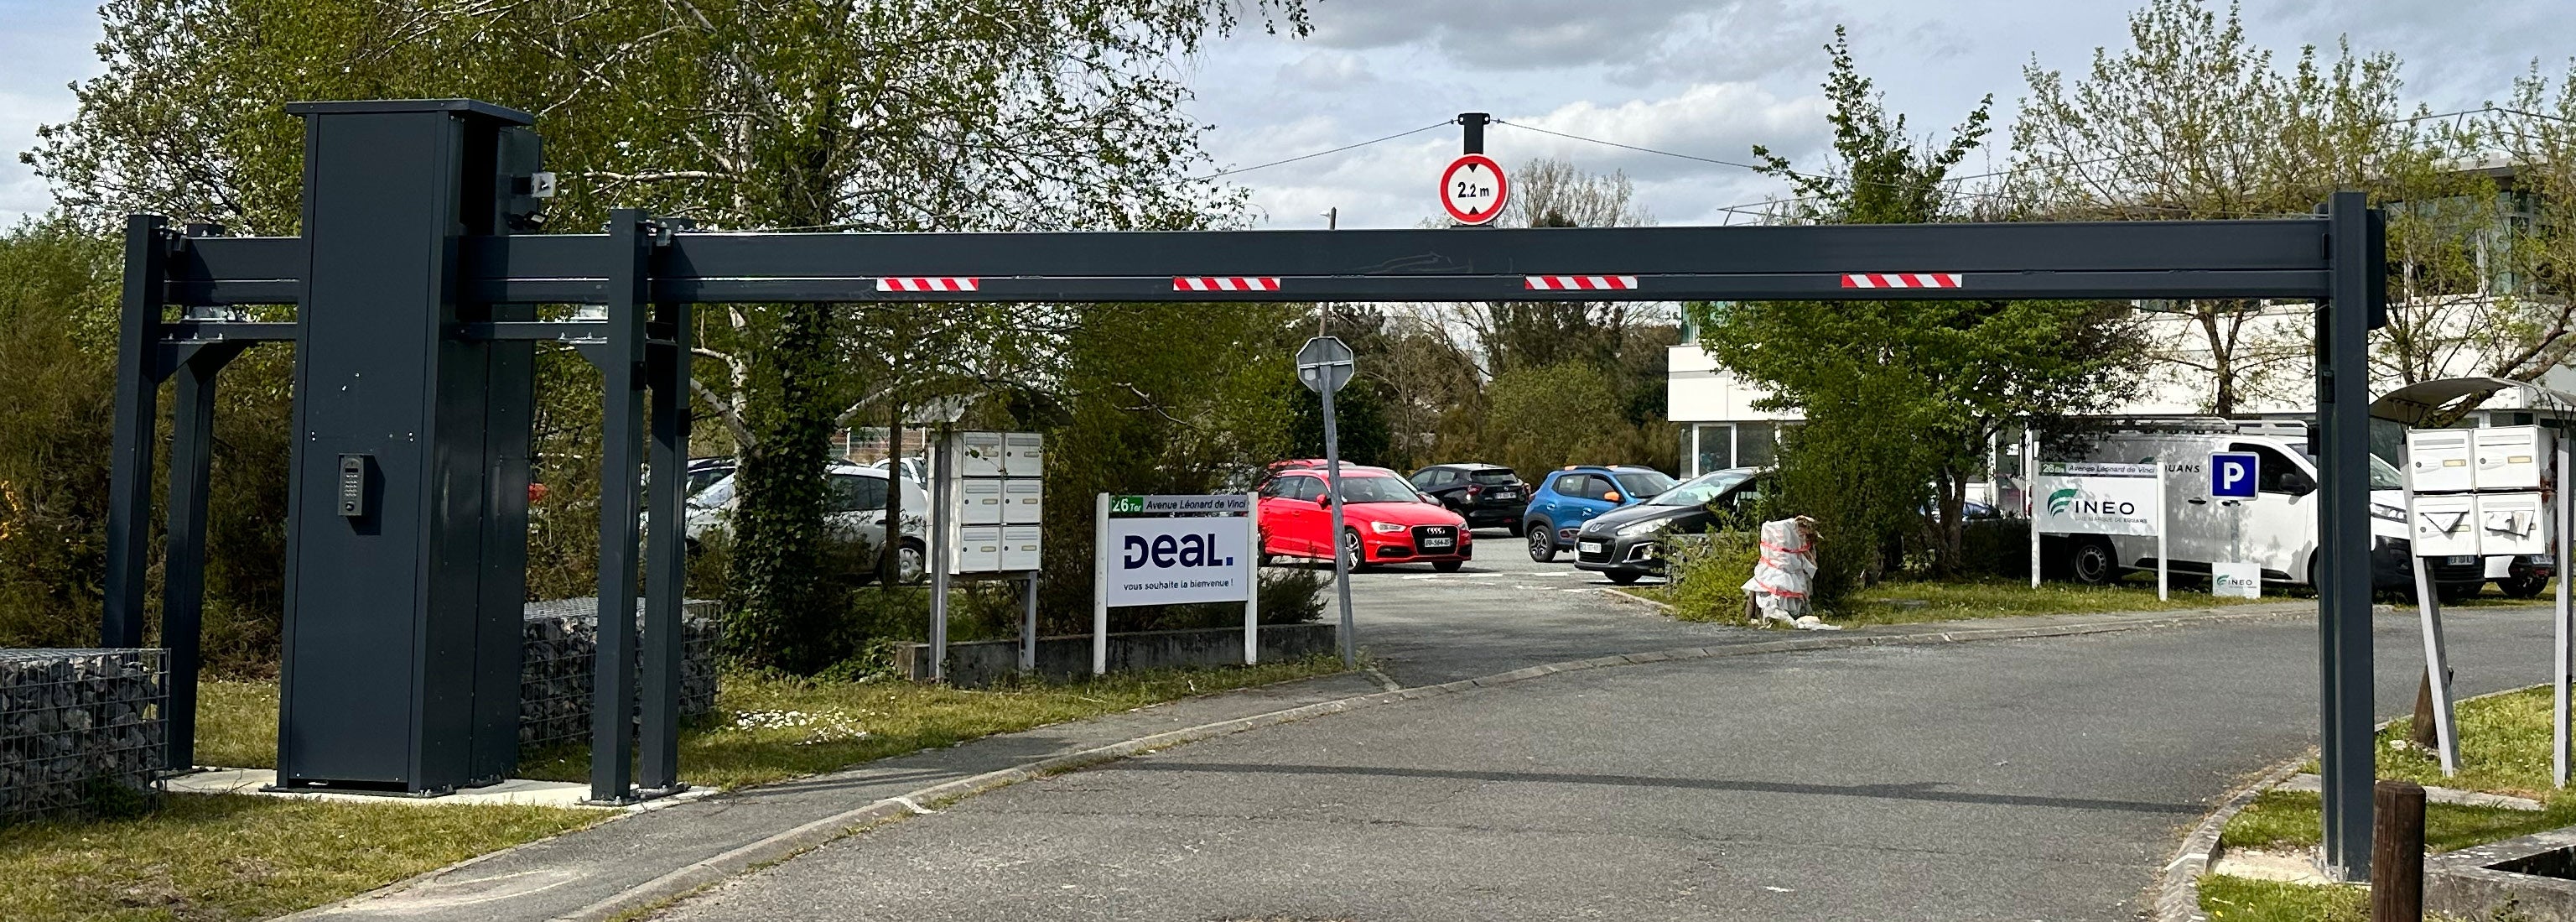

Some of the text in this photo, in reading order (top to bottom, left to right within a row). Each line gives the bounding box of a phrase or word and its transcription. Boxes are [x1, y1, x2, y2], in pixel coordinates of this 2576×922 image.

[1457, 181, 1489, 198] 2.2 m
[2043, 463, 2054, 473] 26
[2165, 464, 2200, 473] UANS
[2223, 461, 2245, 490] P
[1112, 497, 1246, 513] 26 Ter Avenue Léonard de Vinci
[2075, 500, 2135, 515] INEO
[1145, 581, 1178, 590] souhaite
[1181, 579, 1188, 588] la
[1191, 580, 1229, 588] bienvenue
